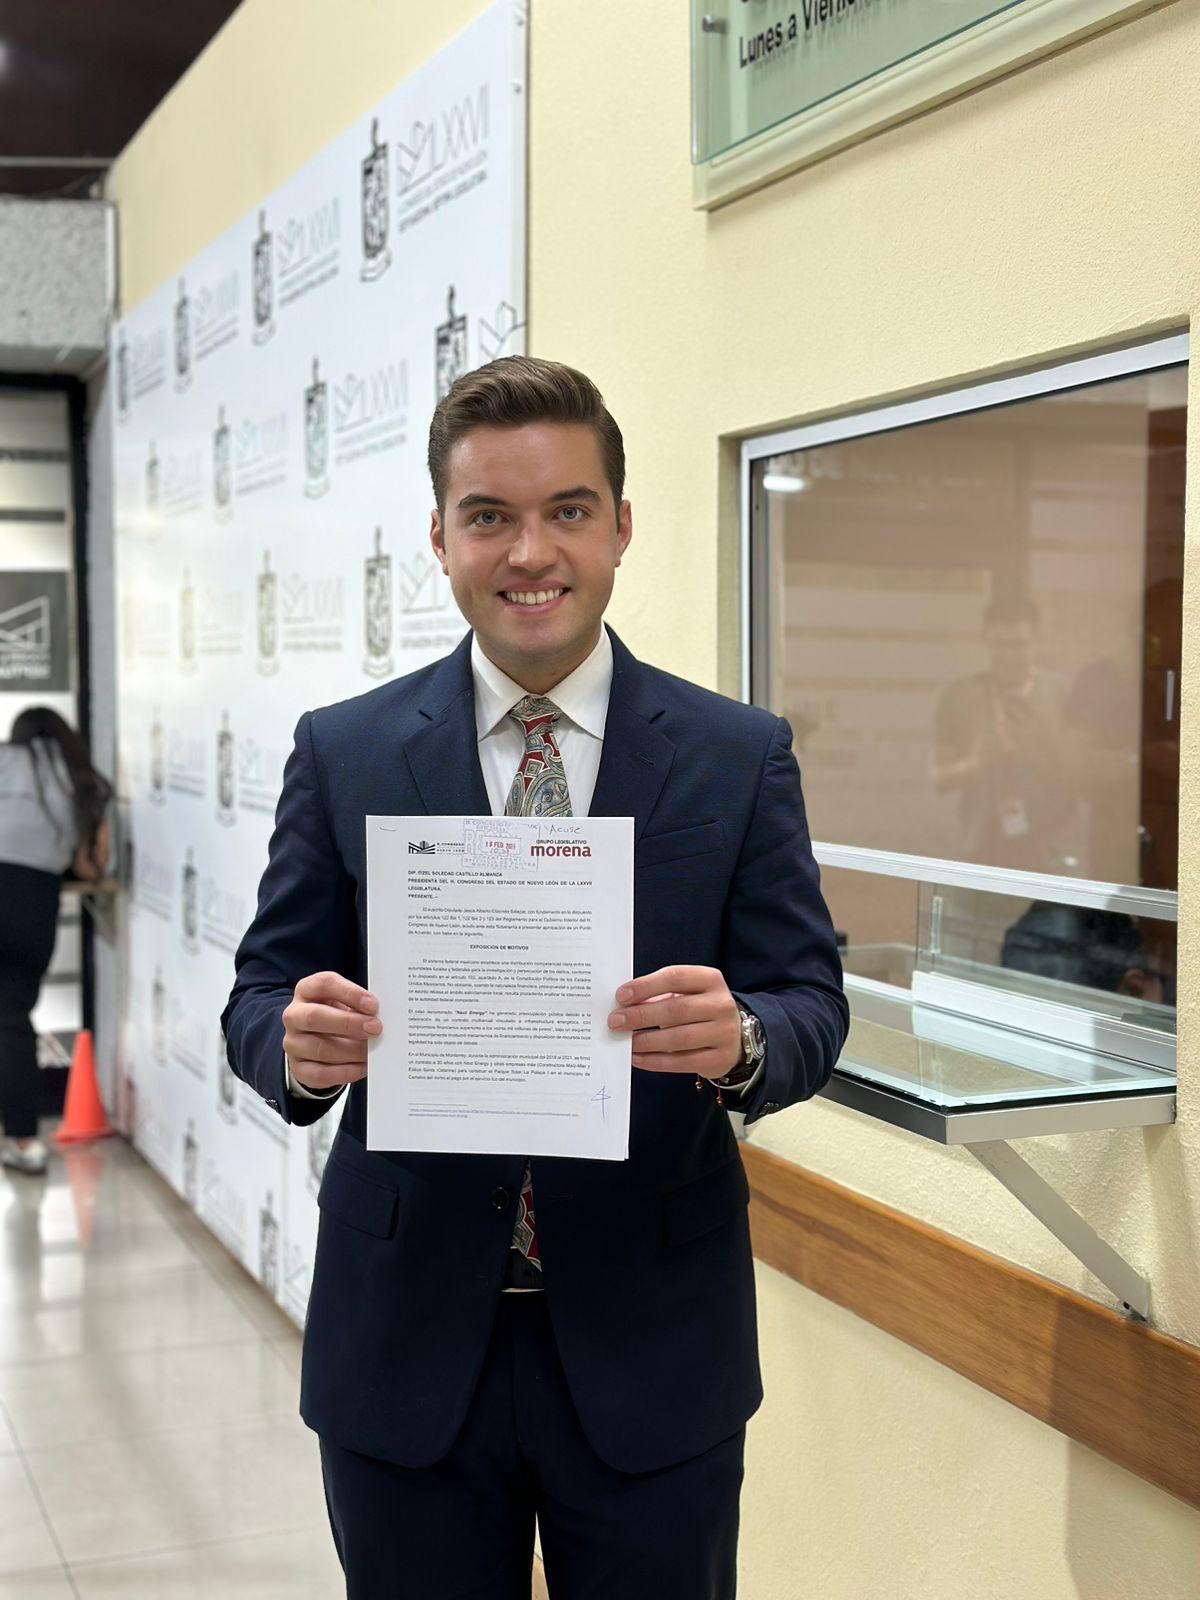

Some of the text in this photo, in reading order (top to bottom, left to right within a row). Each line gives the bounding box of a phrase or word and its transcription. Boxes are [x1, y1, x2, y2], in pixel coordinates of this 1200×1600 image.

[739, 22, 783, 69] Lunes
[788, 13, 798, 40] a
[530, 845, 592, 857] morena
